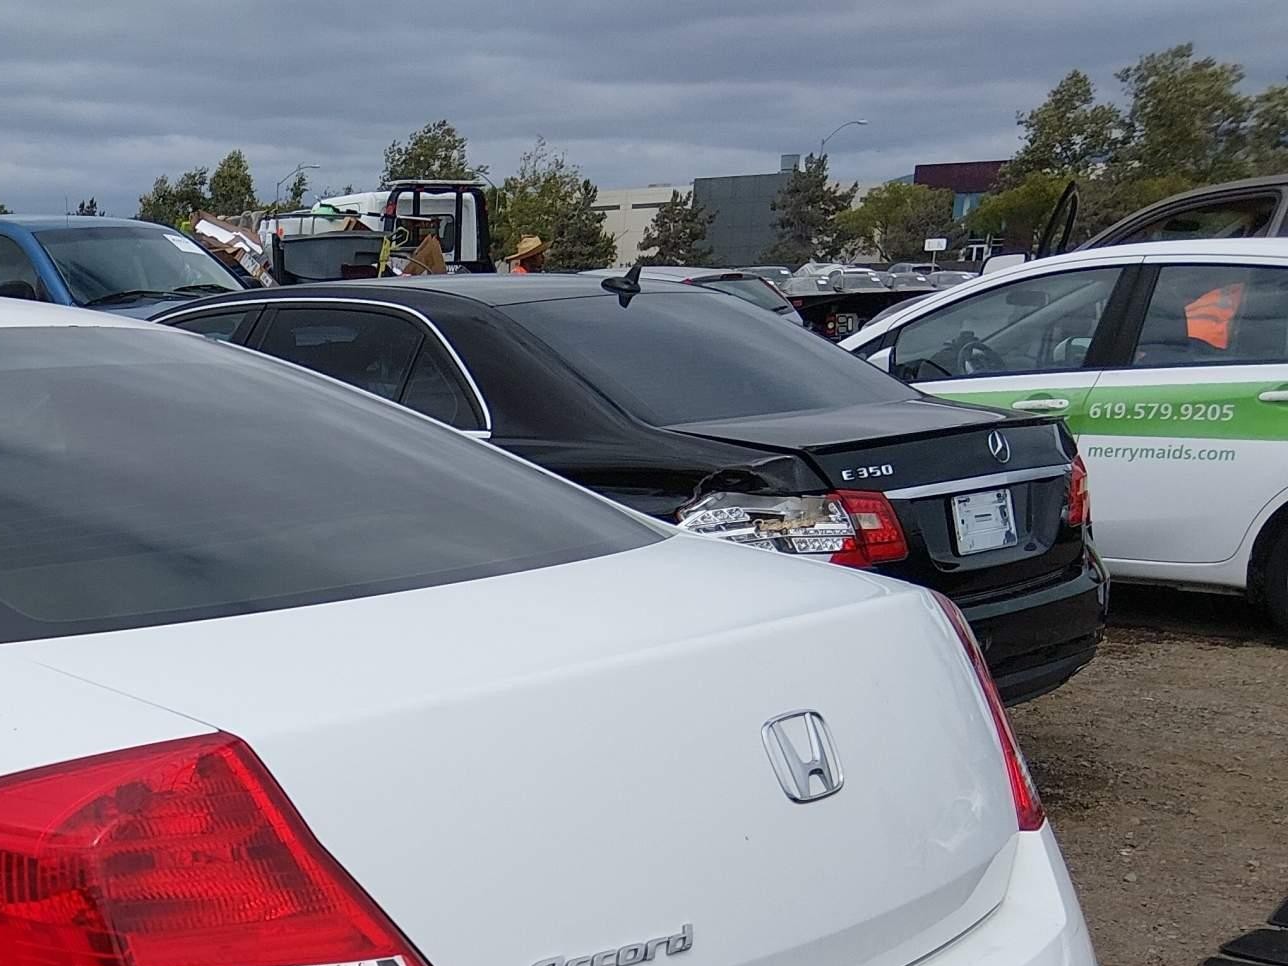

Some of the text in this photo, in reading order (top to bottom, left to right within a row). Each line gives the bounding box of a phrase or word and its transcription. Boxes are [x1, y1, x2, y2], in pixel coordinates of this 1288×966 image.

[1089, 402, 1236, 421] 619.579.9205
[1087, 444, 1236, 463] merrymaids.com
[841, 464, 894, 481] E 350
